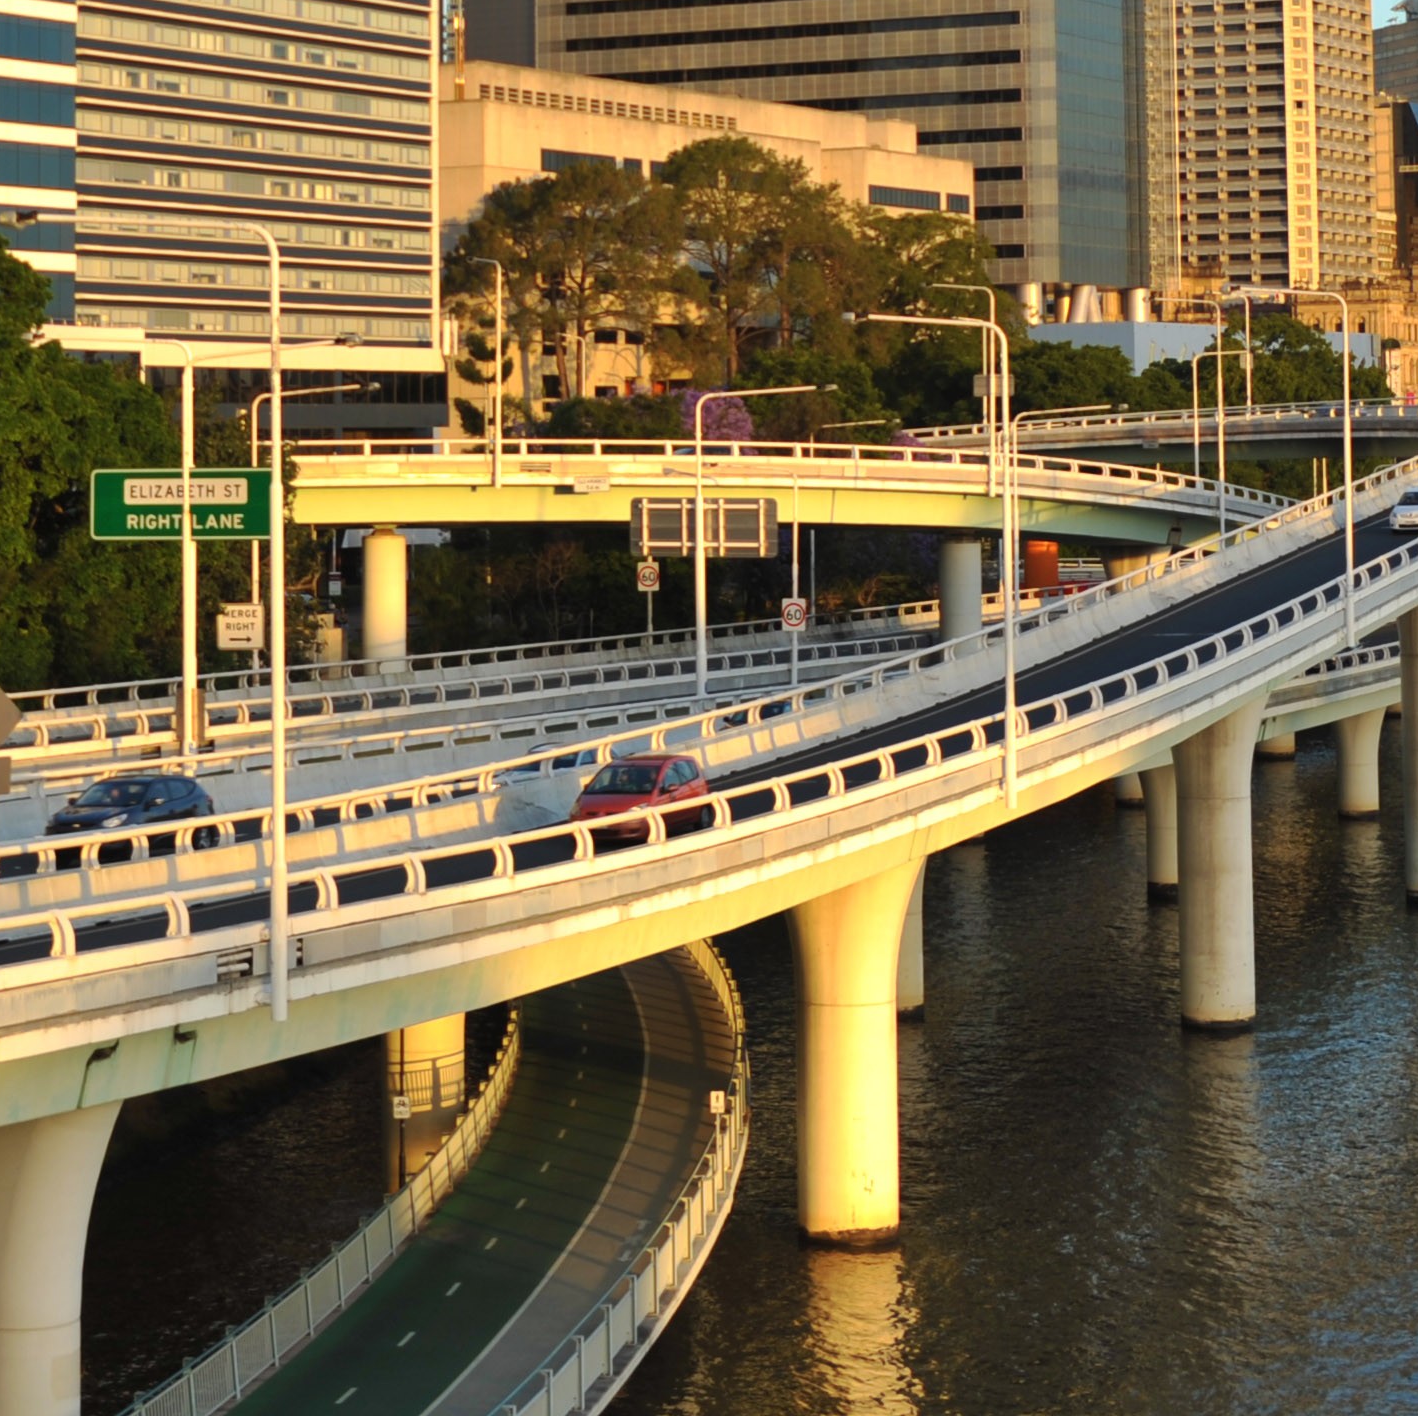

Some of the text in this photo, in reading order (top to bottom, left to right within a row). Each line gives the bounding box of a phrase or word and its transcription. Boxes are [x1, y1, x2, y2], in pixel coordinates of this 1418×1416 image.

[130, 484, 242, 499] ELIZABETH ST
[126, 513, 245, 530] RIGHT LANE
[641, 571, 656, 582] 60
[786, 608, 802, 621] 60
[225, 622, 256, 631] RIGHT
